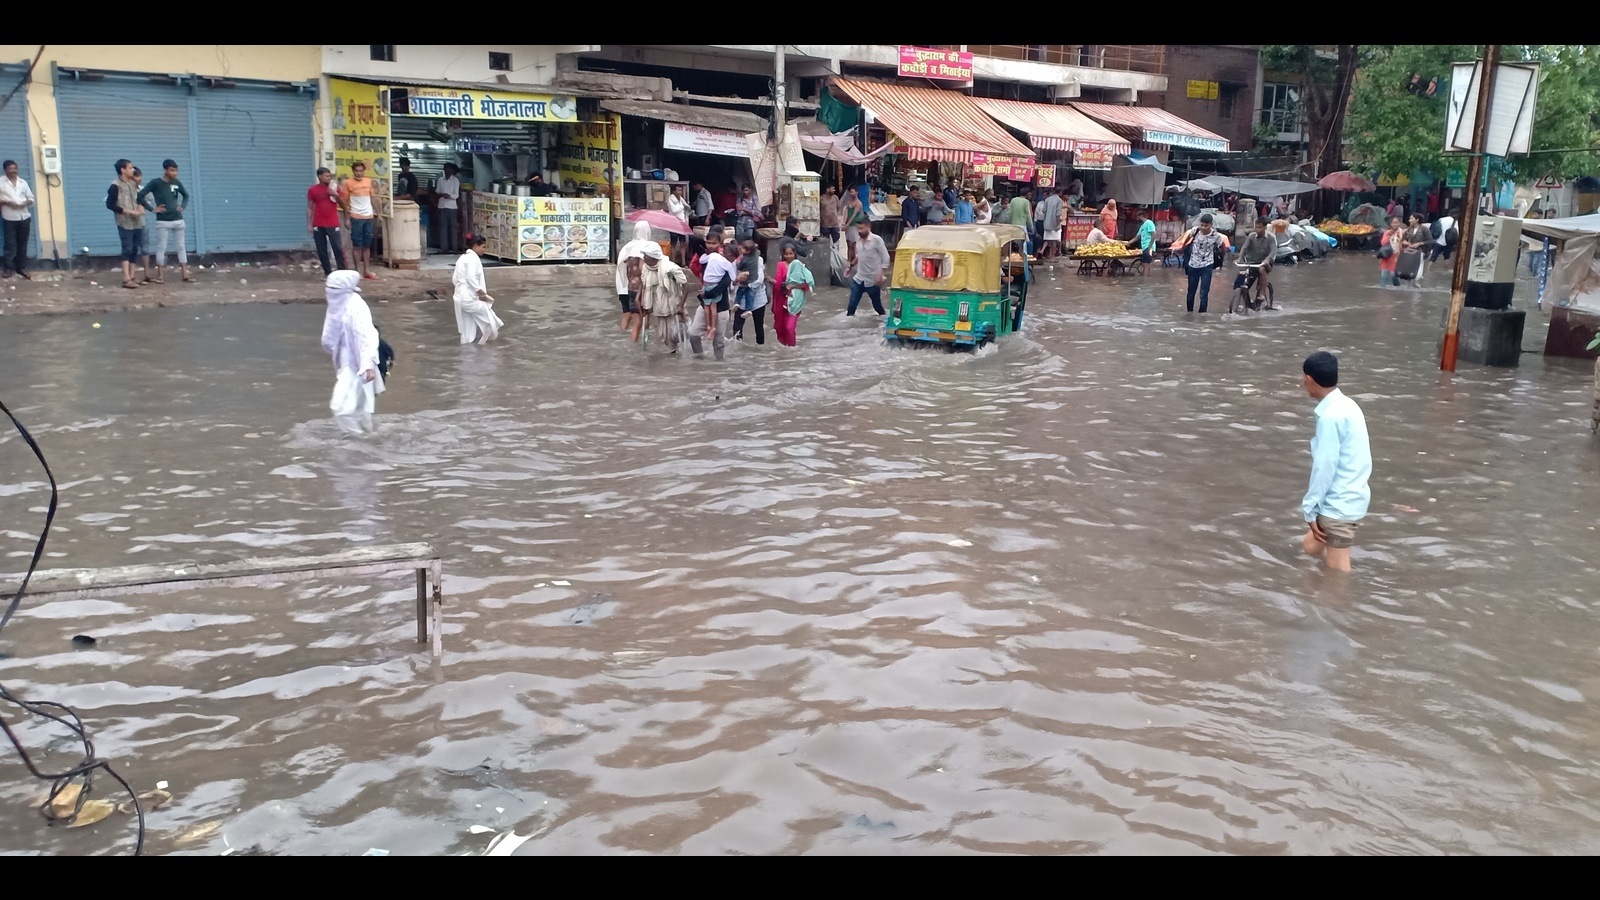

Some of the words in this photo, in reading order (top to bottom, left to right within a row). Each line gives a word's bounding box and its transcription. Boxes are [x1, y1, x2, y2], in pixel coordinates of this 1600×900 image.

[948, 52, 959, 62] की
[930, 65, 938, 74] व
[410, 94, 474, 117] शाकाहारी
[481, 95, 547, 118] भोजनालय
[1148, 131, 1174, 141] SHYAM
[1176, 134, 1181, 143] JI
[1184, 136, 1226, 148] COLLECTION
[544, 200, 557, 211] श्री
[540, 213, 571, 223] शाकाहारी
[574, 212, 607, 223] भोजनालय
